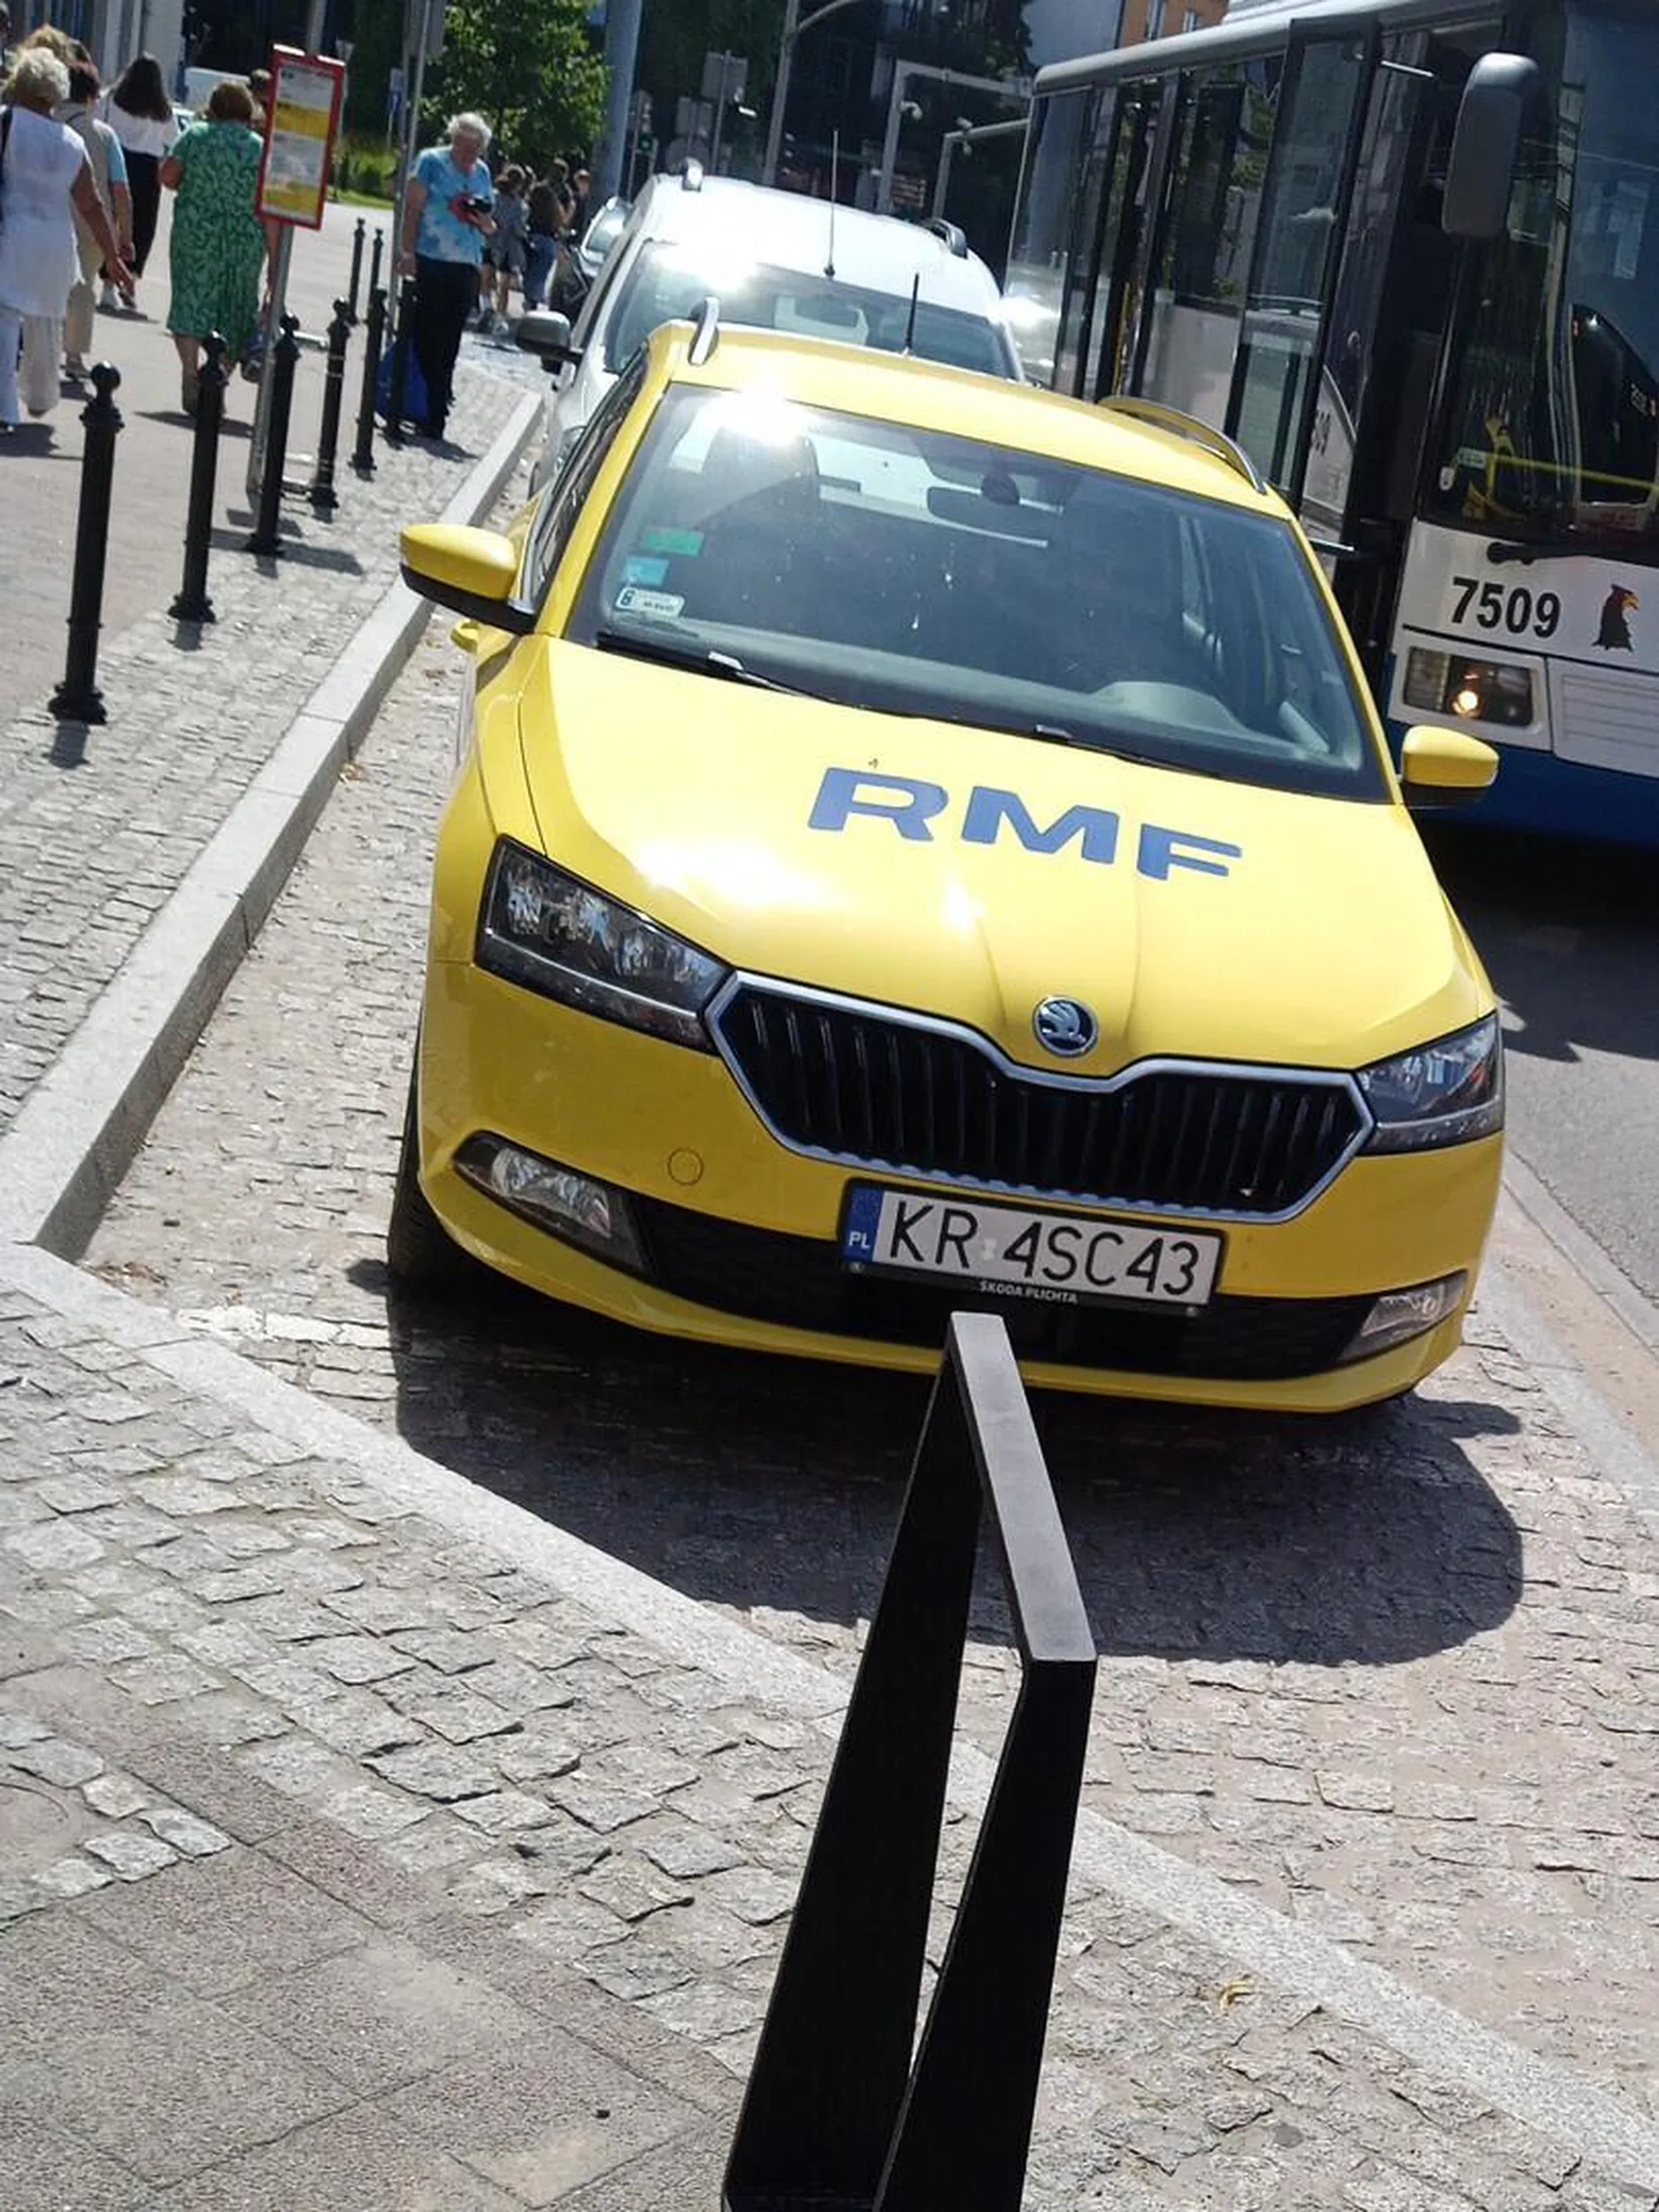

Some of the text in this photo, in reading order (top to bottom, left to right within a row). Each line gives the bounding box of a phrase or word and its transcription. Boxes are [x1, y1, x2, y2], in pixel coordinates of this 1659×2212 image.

[1452, 576, 1561, 638] 7509
[808, 767, 1243, 880] RMF
[849, 1231, 872, 1249] PL
[890, 1201, 1200, 1295] KR 4SC43
